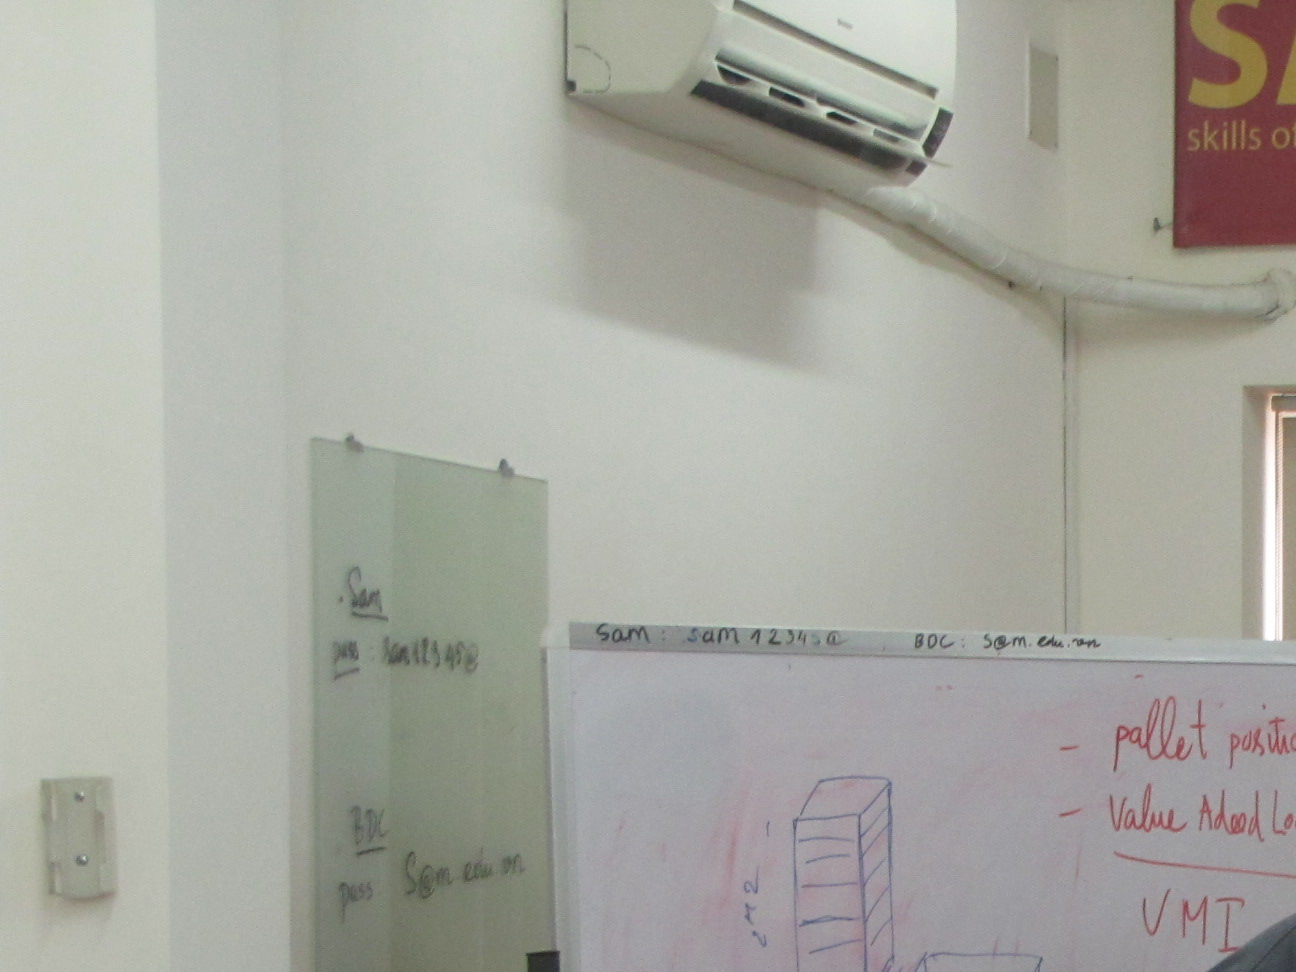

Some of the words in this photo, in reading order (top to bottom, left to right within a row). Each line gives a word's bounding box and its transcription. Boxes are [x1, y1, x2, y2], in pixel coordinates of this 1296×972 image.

[1187, 118, 1261, 152] skills
[1112, 695, 1208, 773] pallet
[1108, 782, 1188, 834] Value
